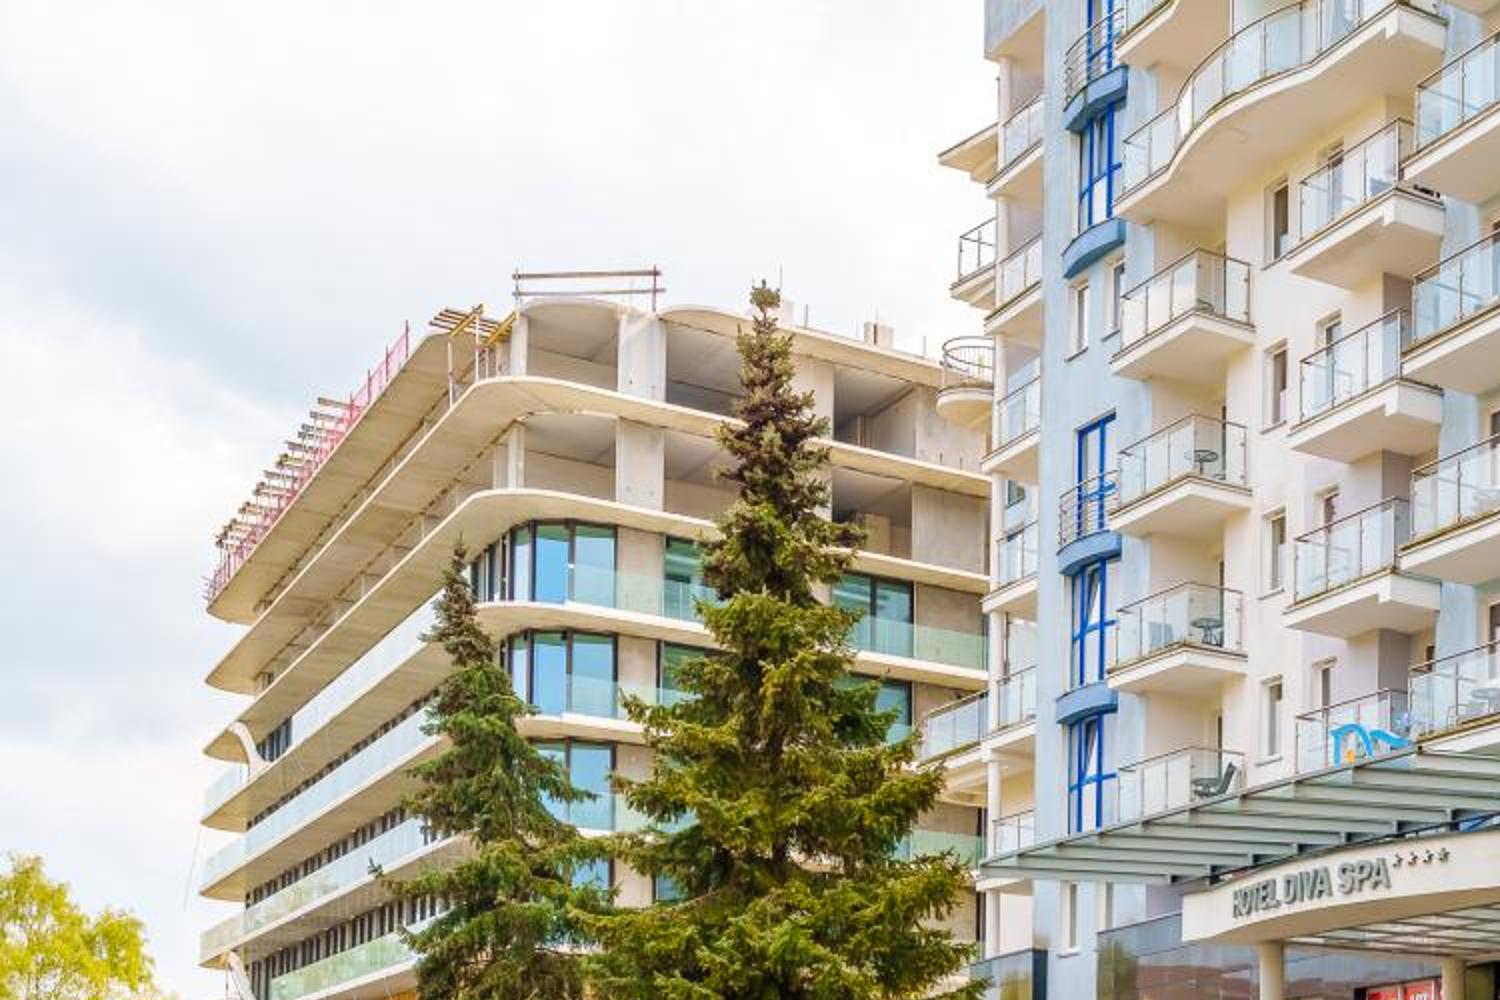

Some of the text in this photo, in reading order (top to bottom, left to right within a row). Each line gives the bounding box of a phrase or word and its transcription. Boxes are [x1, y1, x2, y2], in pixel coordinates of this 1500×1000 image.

[1232, 857, 1392, 918] HOTEL DIVA SPA
